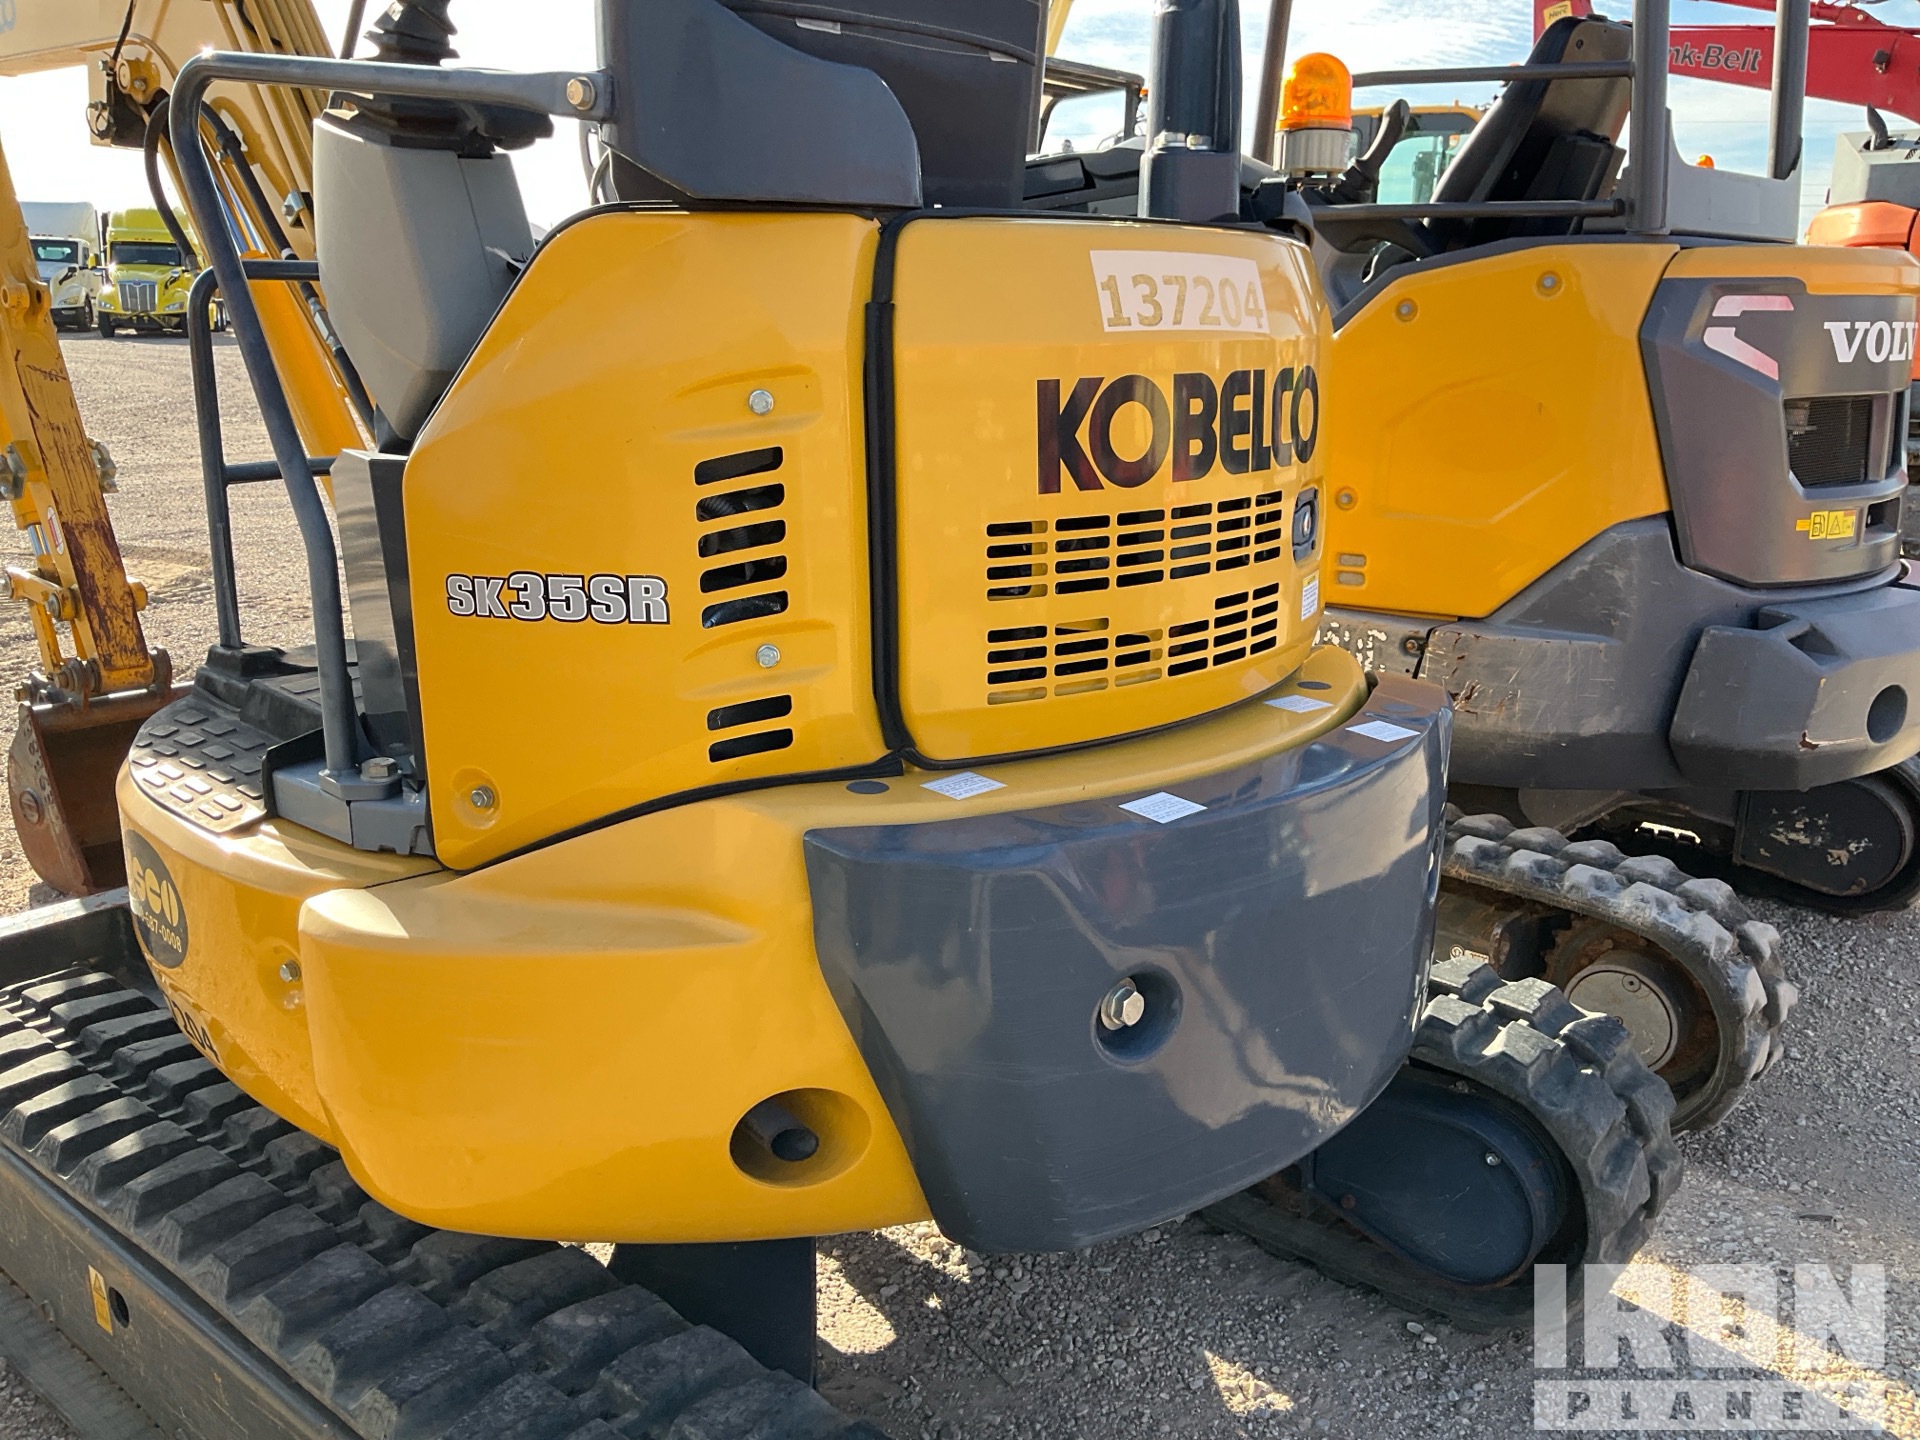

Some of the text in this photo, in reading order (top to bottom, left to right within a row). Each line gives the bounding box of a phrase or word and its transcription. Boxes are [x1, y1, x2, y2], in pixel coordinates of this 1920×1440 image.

[1100, 273, 1264, 329] 137204
[1037, 365, 1319, 495] KOBELCO
[445, 570, 670, 625] SK35SR
